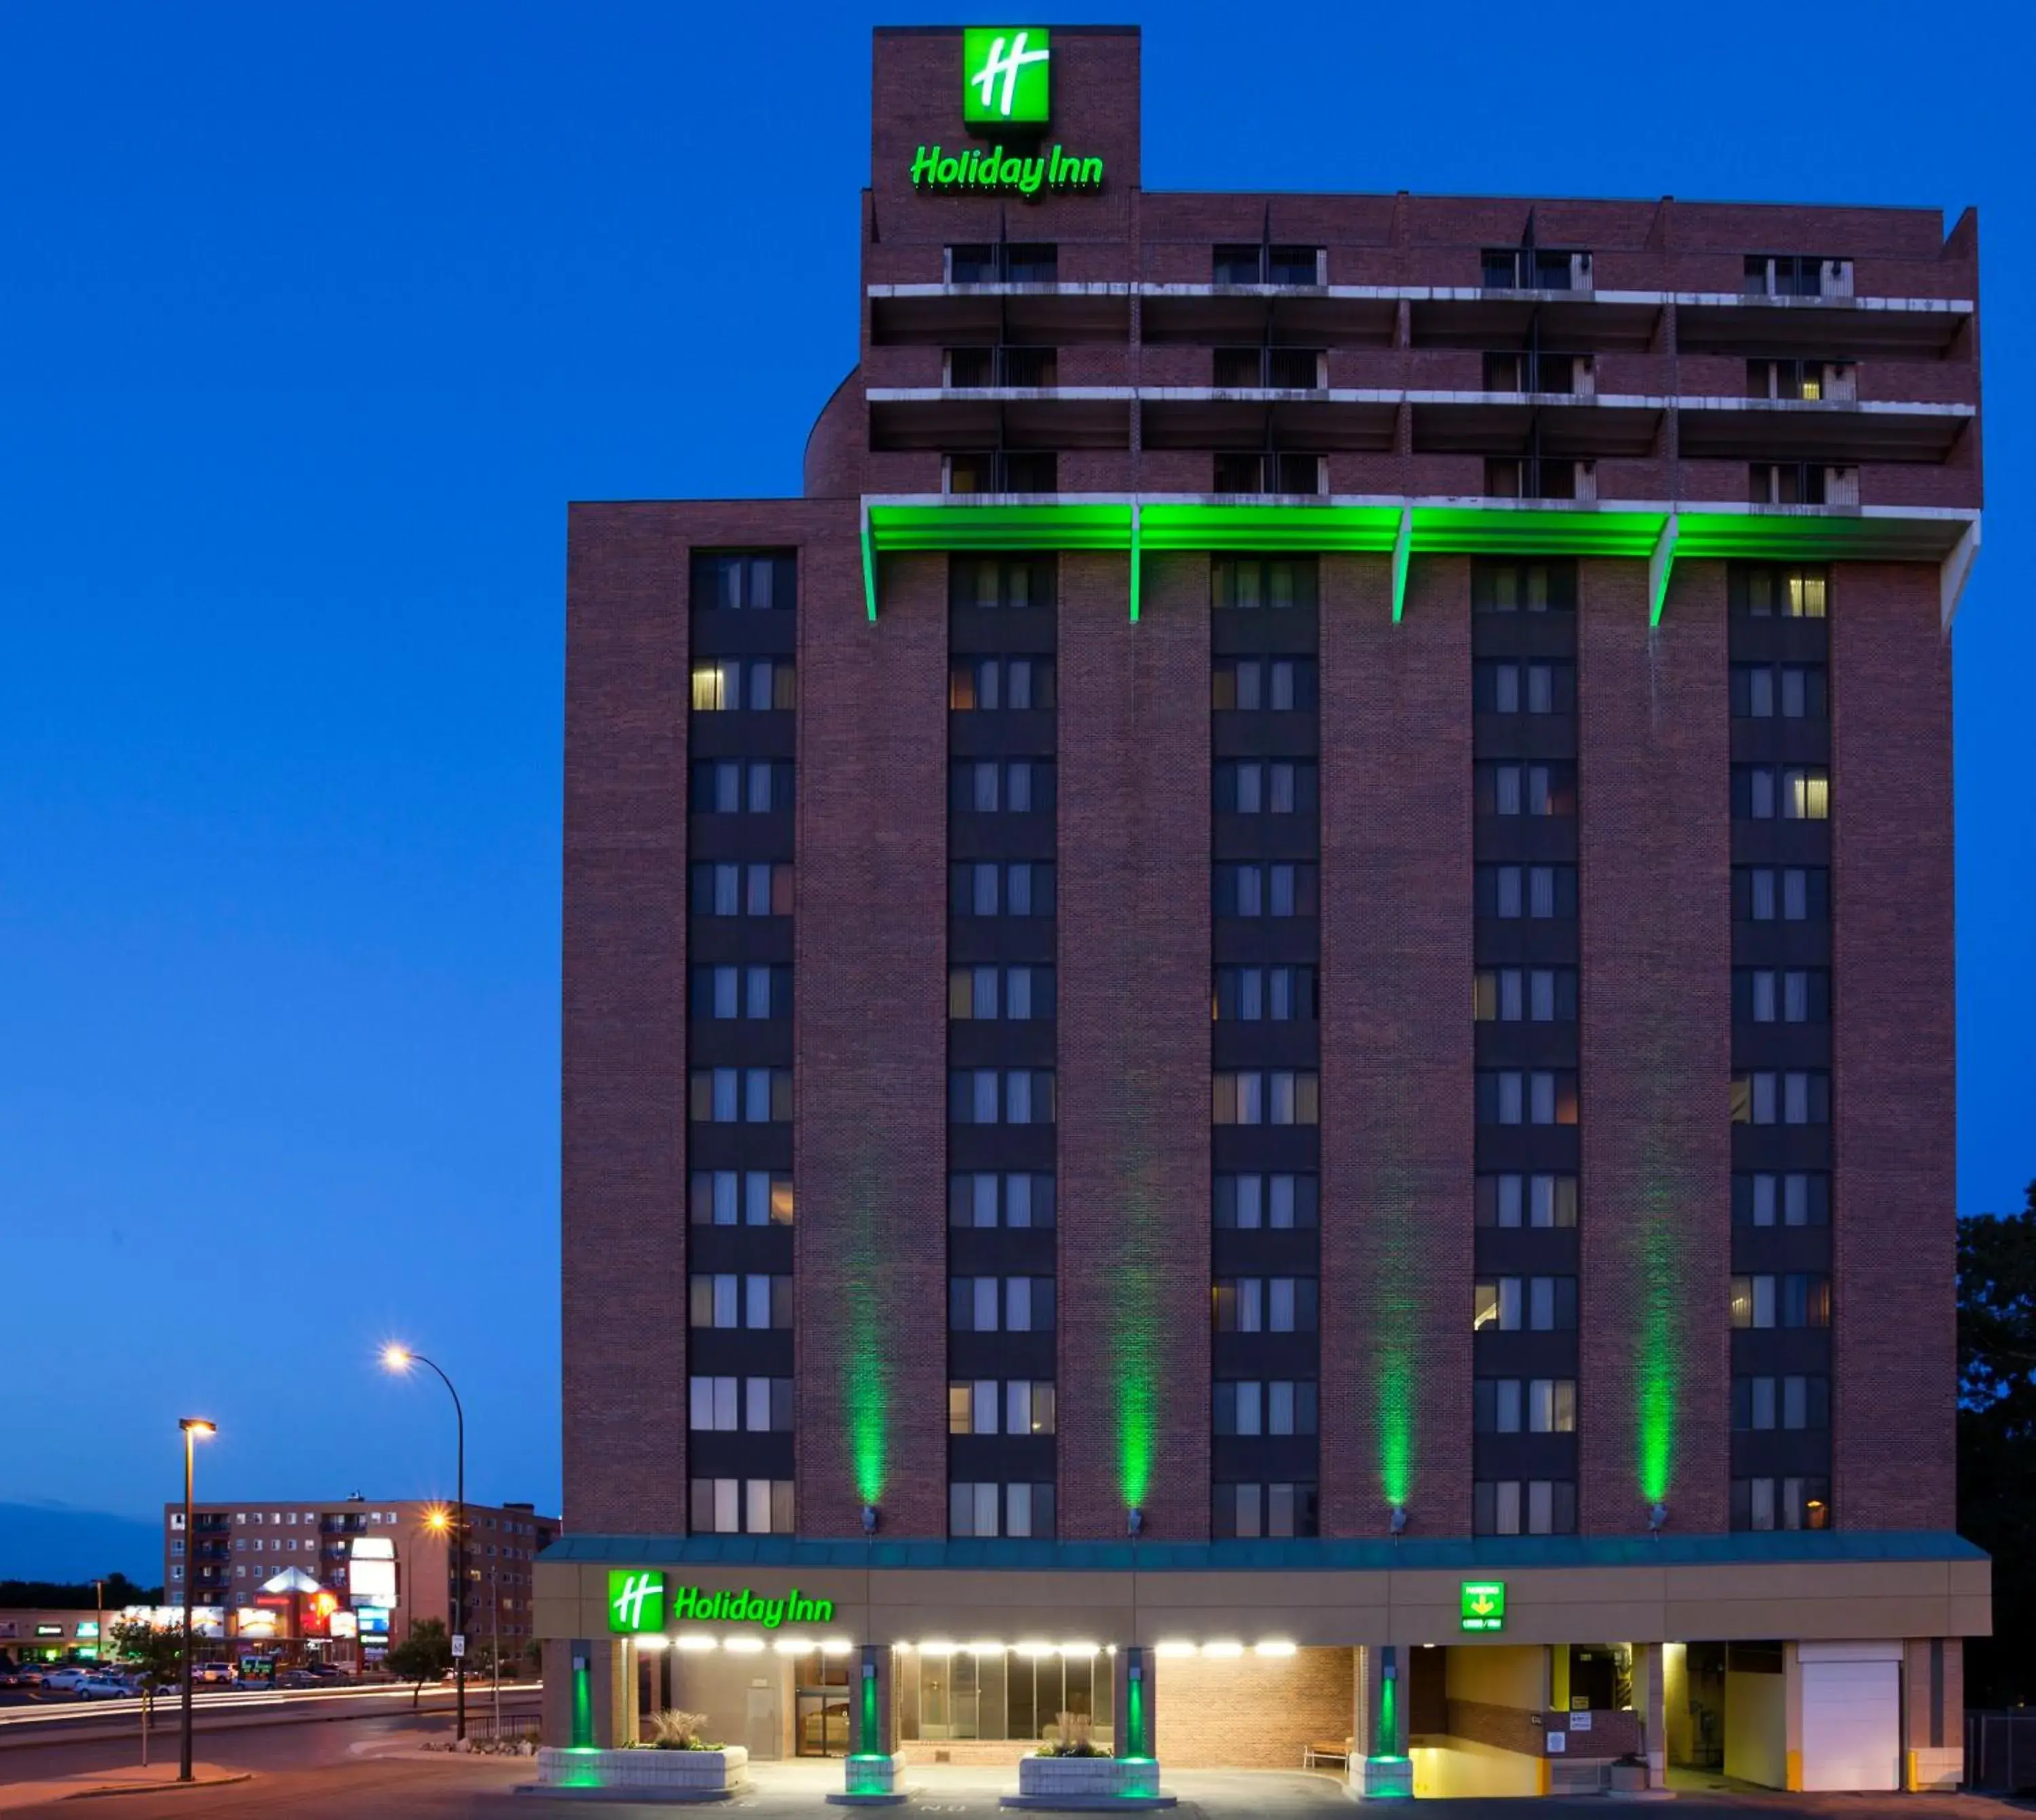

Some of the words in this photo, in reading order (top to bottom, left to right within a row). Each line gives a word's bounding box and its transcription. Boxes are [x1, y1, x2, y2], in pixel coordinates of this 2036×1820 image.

[971, 32, 1049, 115] H
[911, 145, 1044, 193] Holiday
[1049, 144, 1103, 183] Inn
[613, 1574, 663, 1629] H
[674, 1586, 784, 1628] Holiday
[787, 1588, 834, 1622] Inn
